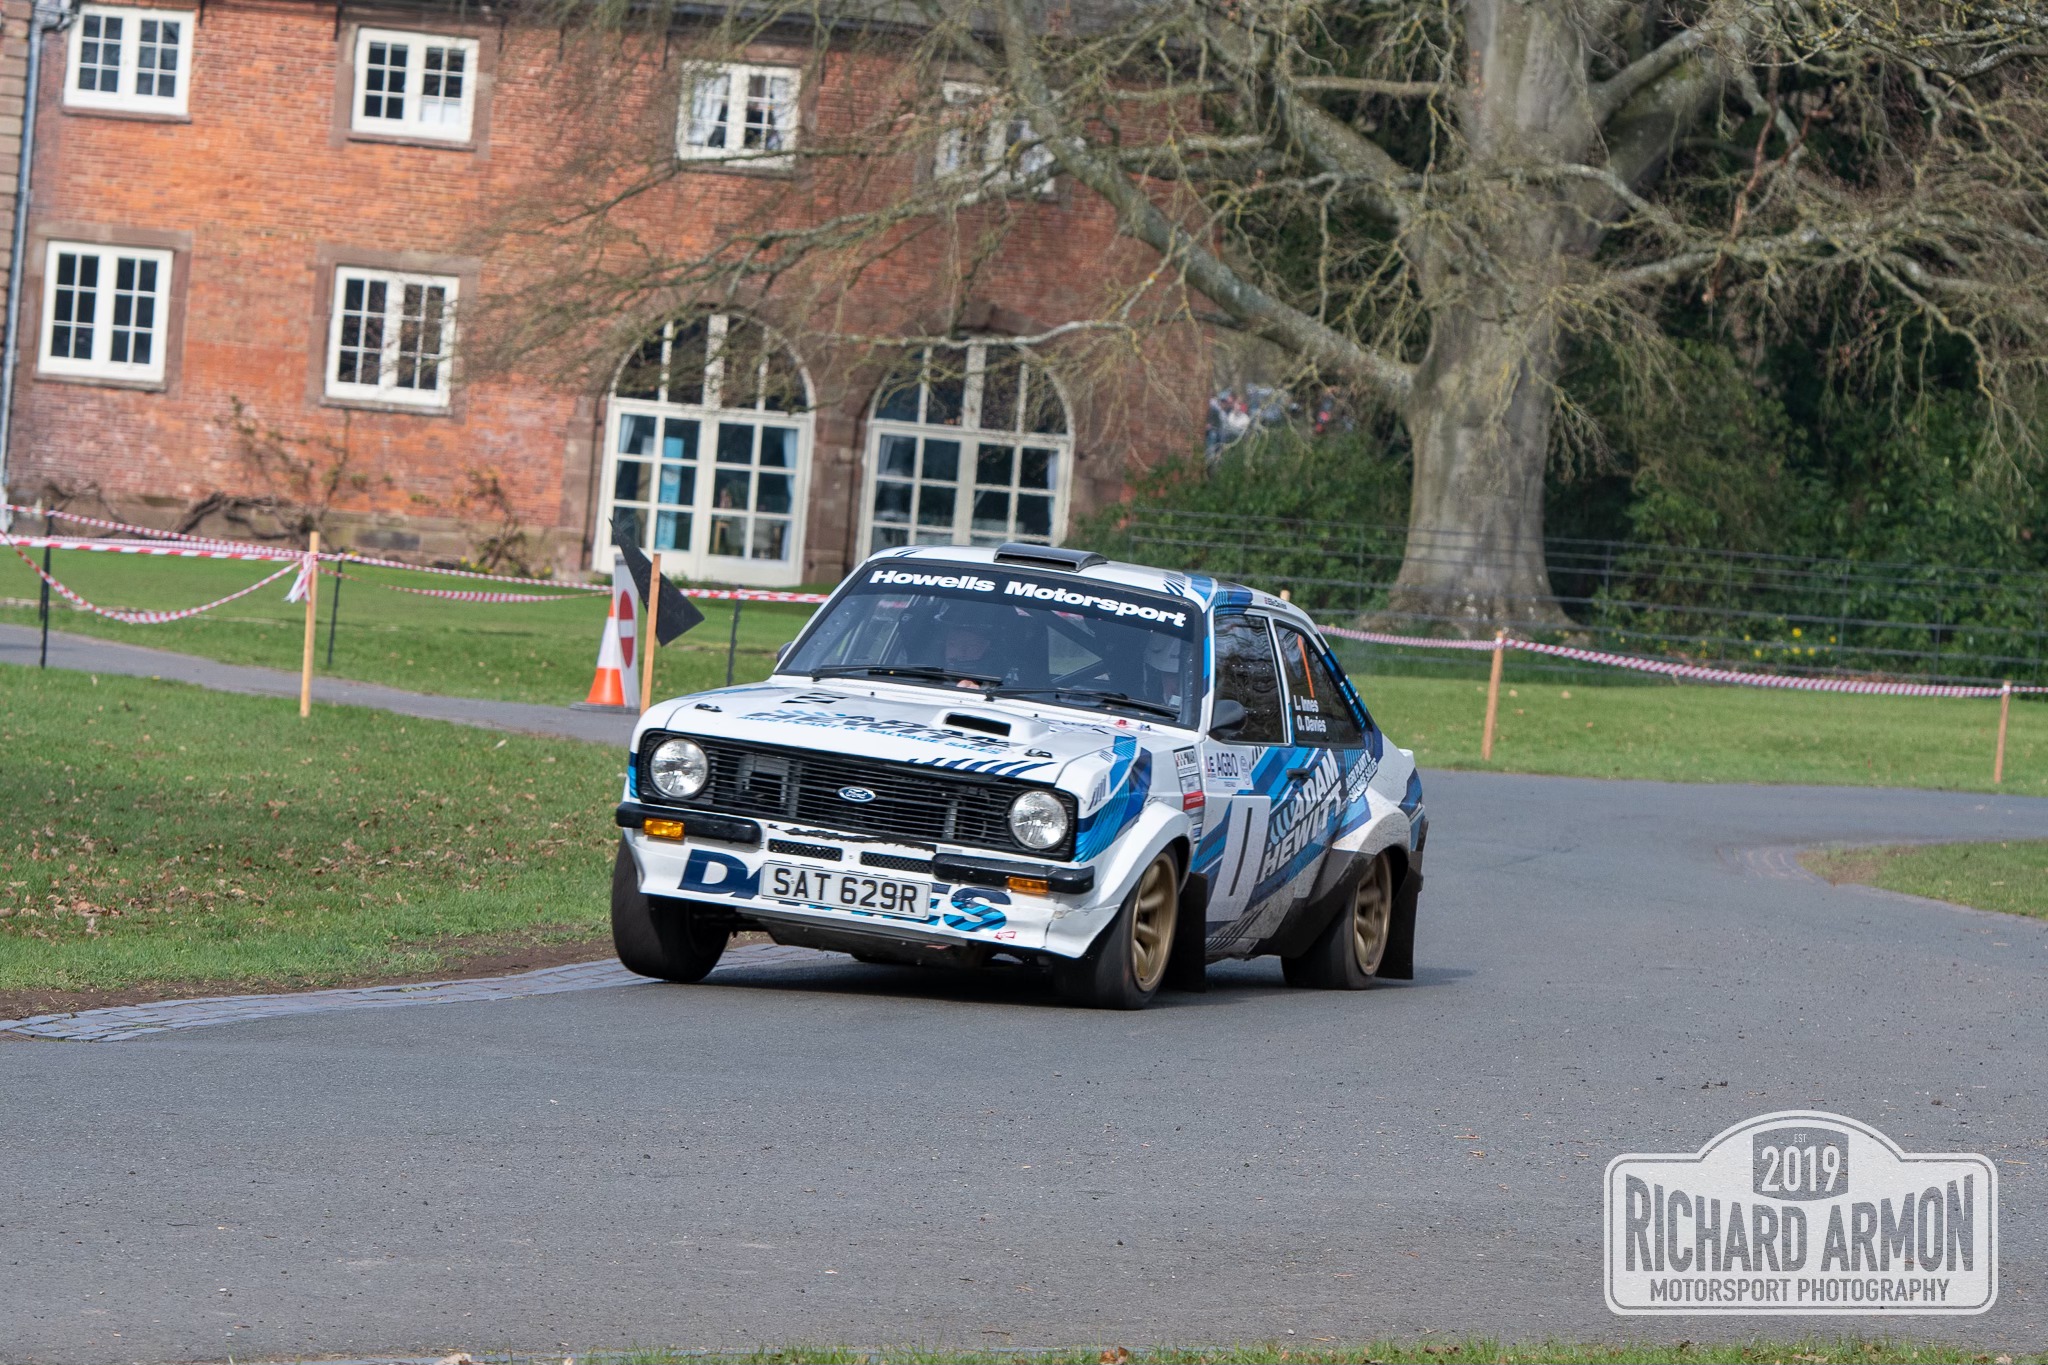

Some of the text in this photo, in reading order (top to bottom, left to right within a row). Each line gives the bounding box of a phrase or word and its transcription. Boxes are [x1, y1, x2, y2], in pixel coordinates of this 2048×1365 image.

[869, 570, 1187, 628] Howells Motorsport
[1293, 695, 1320, 713] L. Innes
[1304, 716, 1327, 733] Davies
[783, 720, 842, 728] PLANT
[863, 728, 940, 744] SALVAGE
[944, 742, 1003, 755] SALES
[1216, 752, 1239, 777] AGBO
[1290, 748, 1340, 830] ADAM
[1259, 780, 1343, 884] HEWITT
[773, 866, 919, 914] SAT 629R
